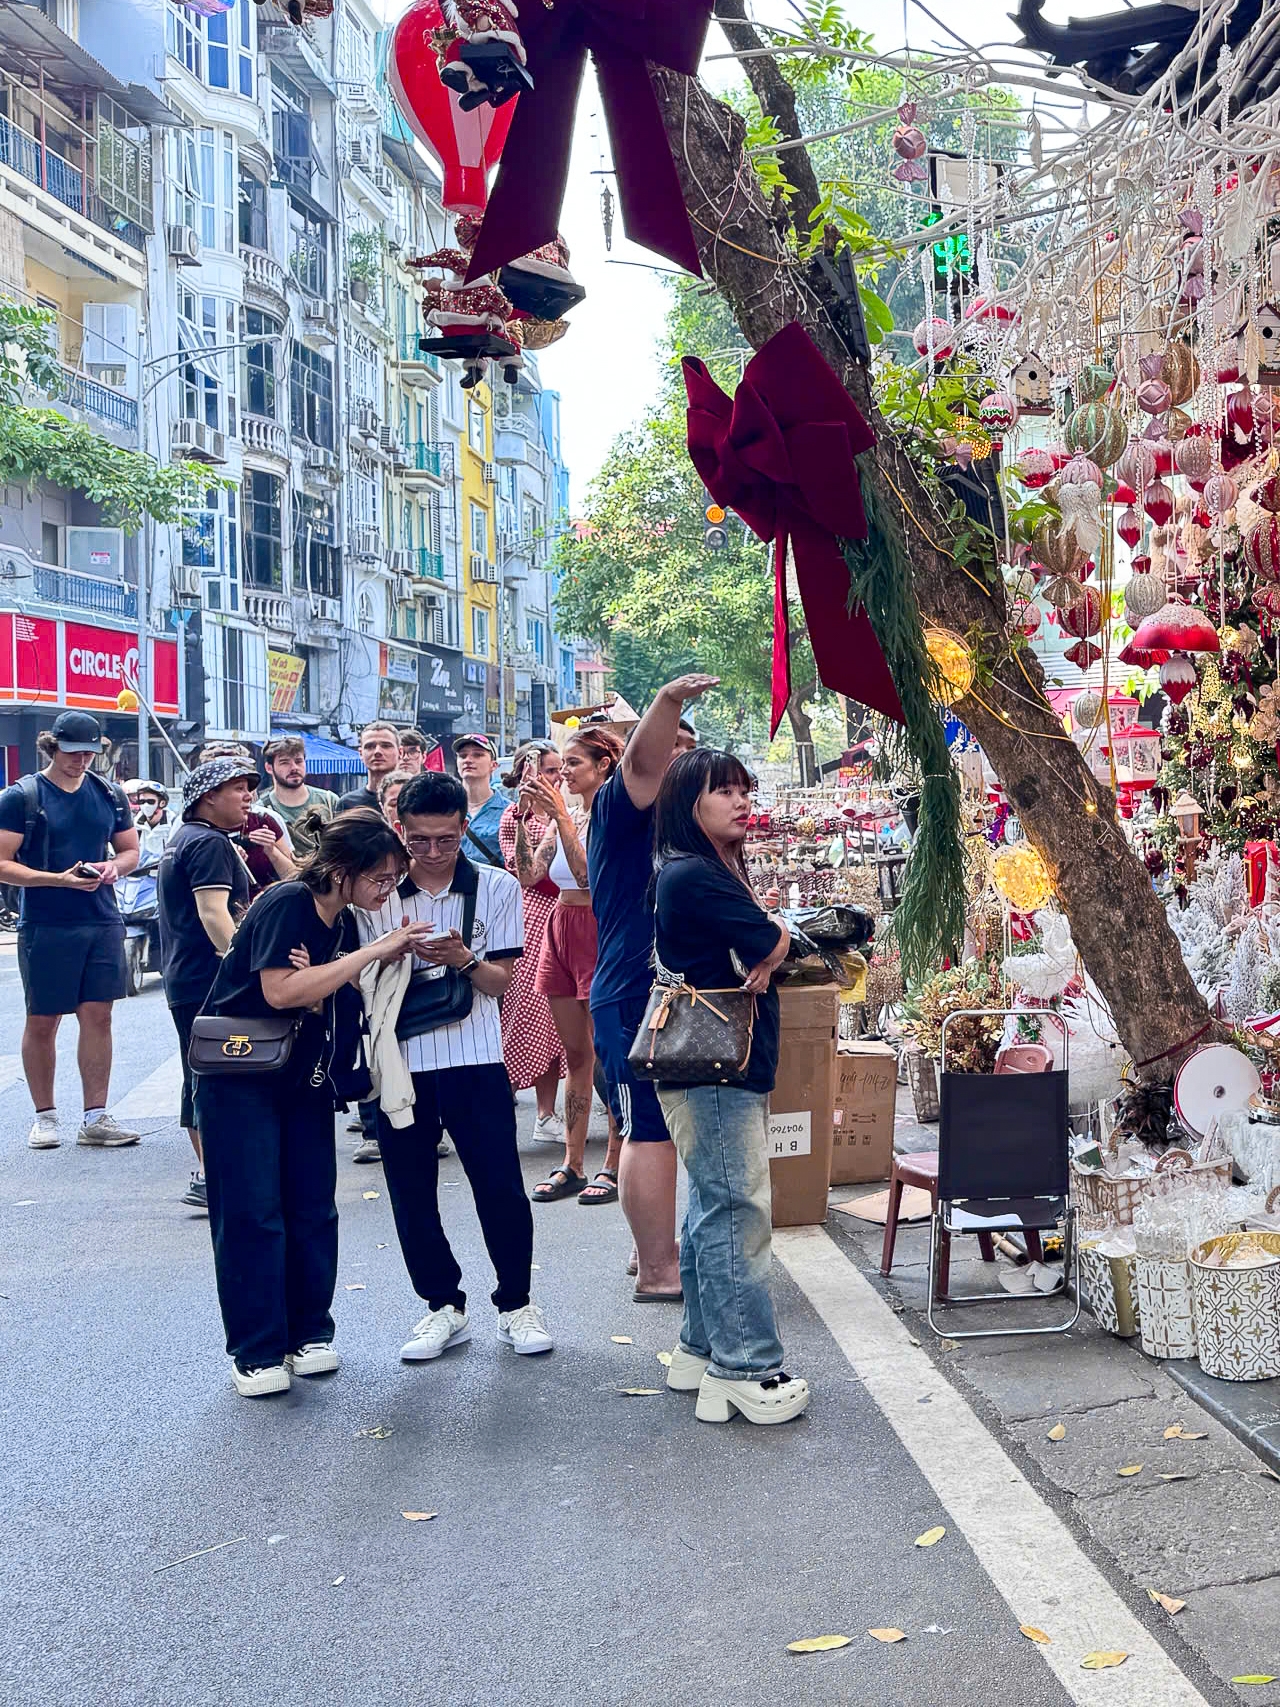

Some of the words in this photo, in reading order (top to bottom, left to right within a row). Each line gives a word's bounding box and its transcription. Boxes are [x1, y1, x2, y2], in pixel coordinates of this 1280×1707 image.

[69, 648, 121, 679] CIRCLE
[775, 1142, 783, 1153] H
[790, 1140, 798, 1151] B
